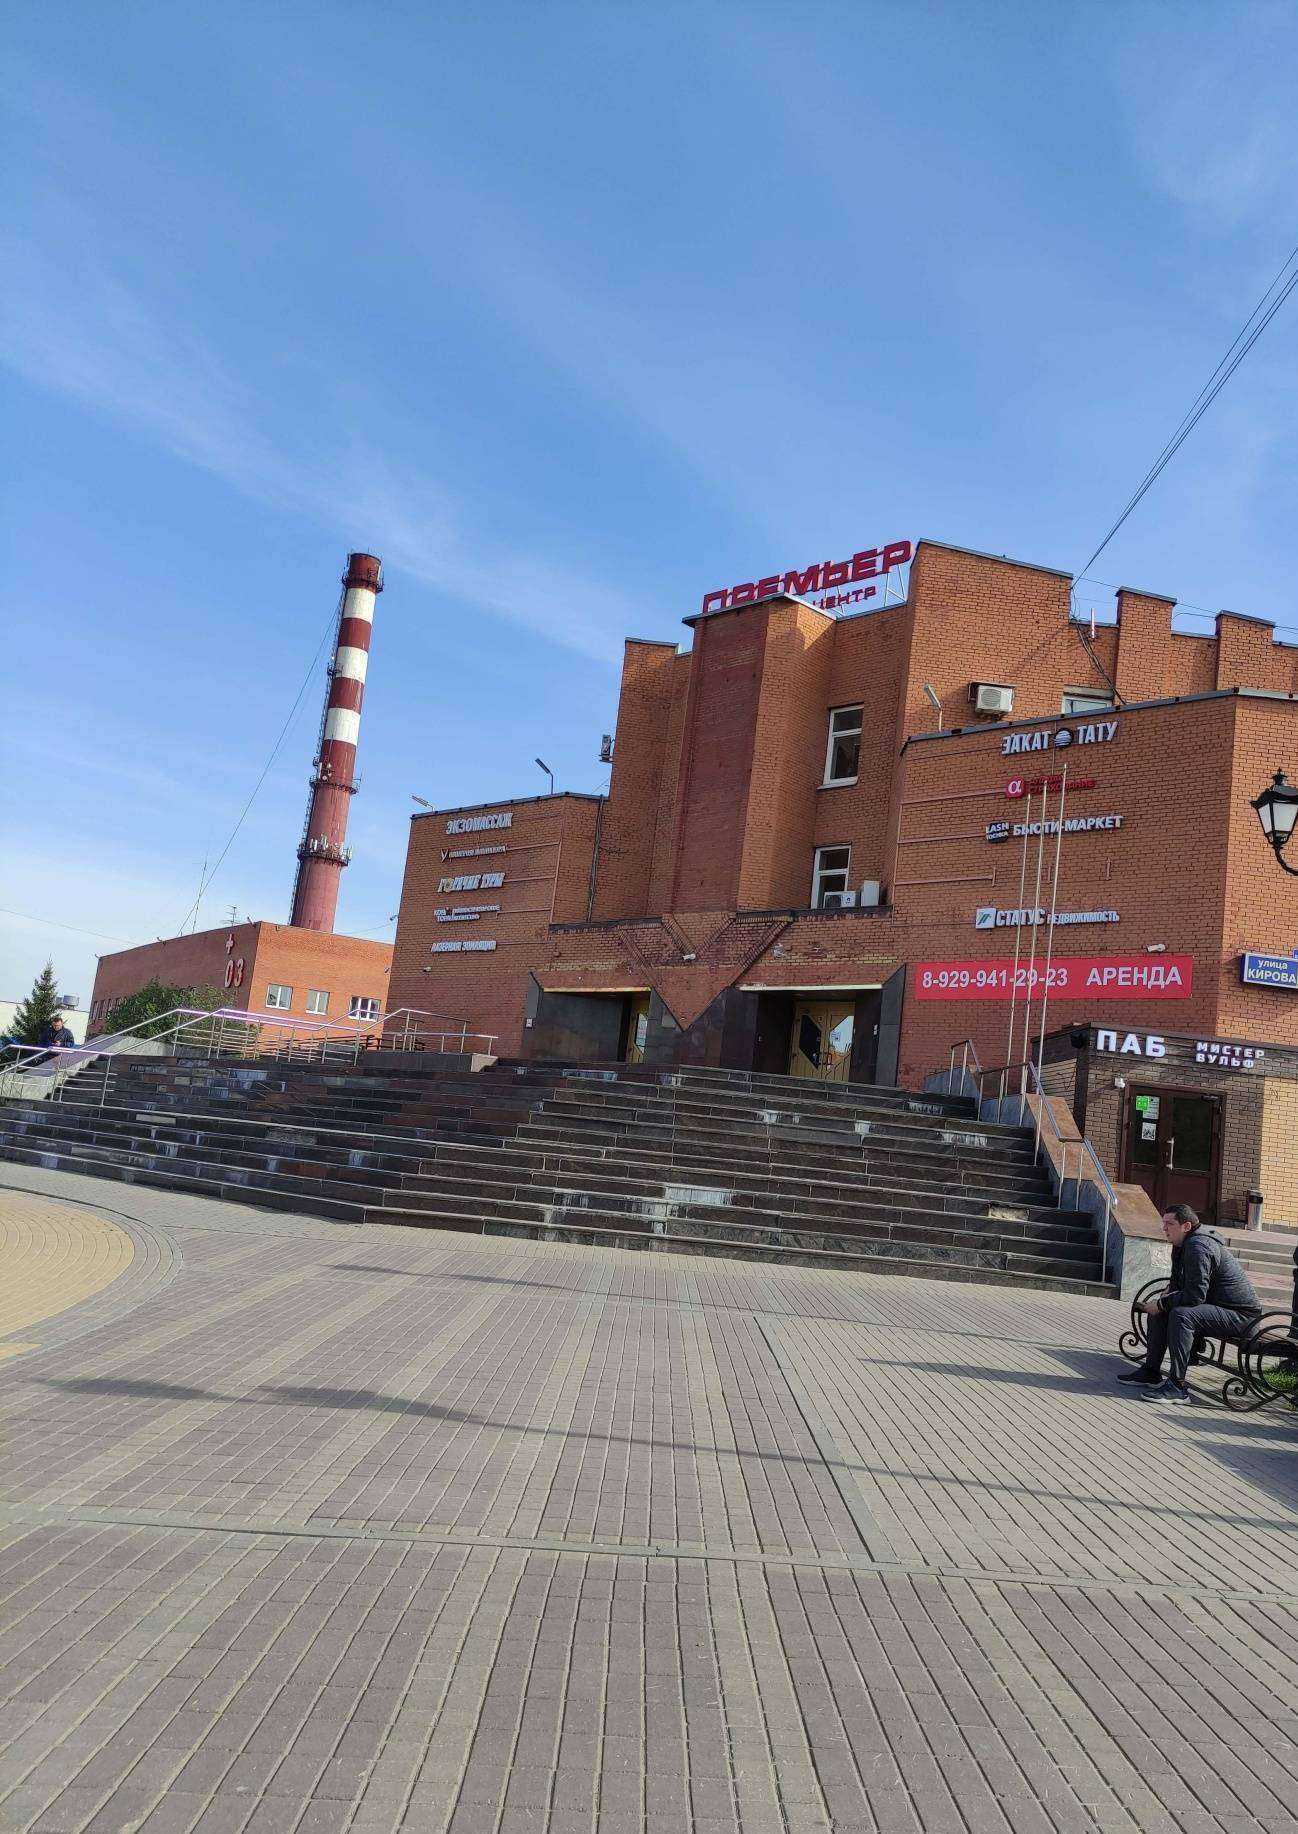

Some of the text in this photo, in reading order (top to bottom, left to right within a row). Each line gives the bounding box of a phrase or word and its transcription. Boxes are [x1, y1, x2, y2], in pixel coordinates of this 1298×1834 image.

[703, 540, 911, 613] ПРЕМЬЕР
[1001, 721, 1118, 755] ЗАКАТ ТАТУ
[996, 908, 1046, 926] СТАТУС
[224, 958, 244, 988] 03
[1257, 959, 1288, 970] улица
[922, 966, 1183, 990] 8-929-941-29-23 АРЕНДА
[1248, 968, 1297, 984] КИРОВА
[1097, 1030, 1166, 1058] ПАБ
[1196, 1041, 1265, 1059] МИСТЕР
[1195, 1053, 1255, 1069] ВУЛЬФ
